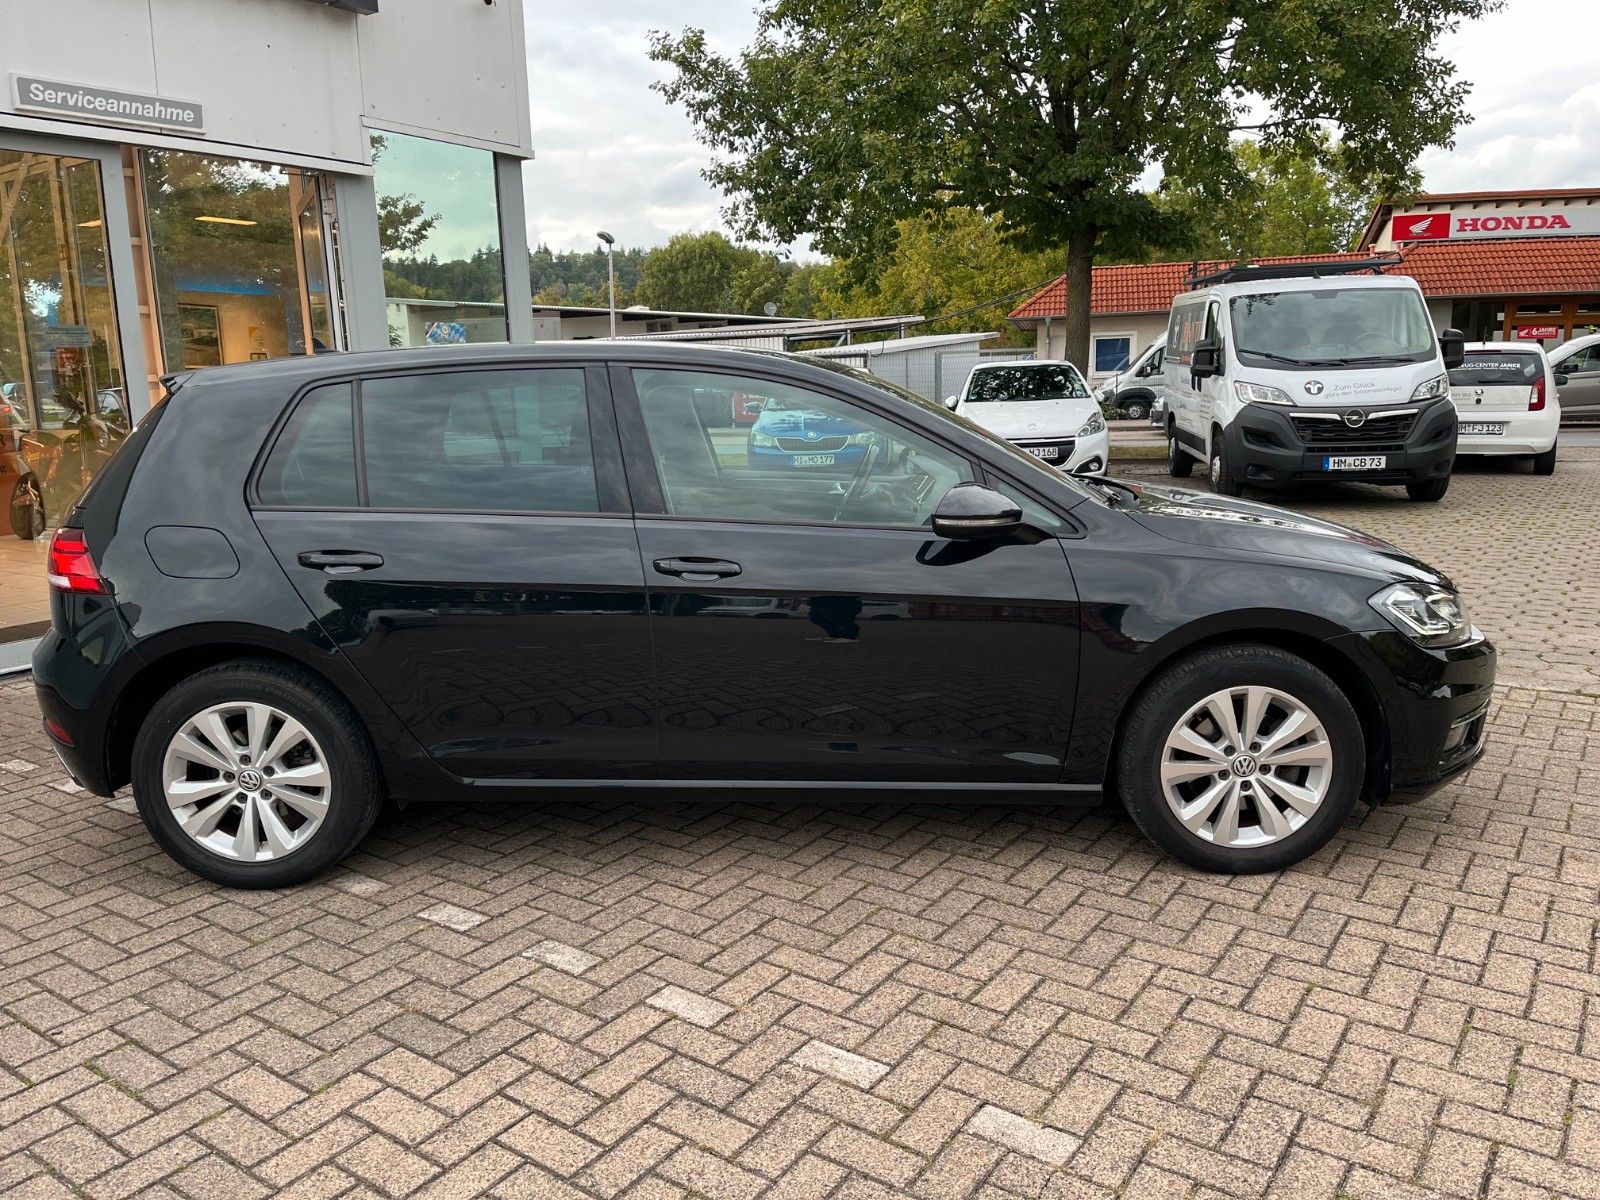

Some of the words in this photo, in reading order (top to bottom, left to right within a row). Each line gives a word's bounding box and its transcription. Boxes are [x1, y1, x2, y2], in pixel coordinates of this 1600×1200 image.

[29, 83, 194, 123] Serviceannahme
[1456, 214, 1571, 233] HONDA
[1531, 327, 1538, 336] 6
[1041, 447, 1057, 457] 168
[1332, 458, 1347, 468] HM
[1353, 457, 1367, 468] CB
[1369, 457, 1382, 467] 73
